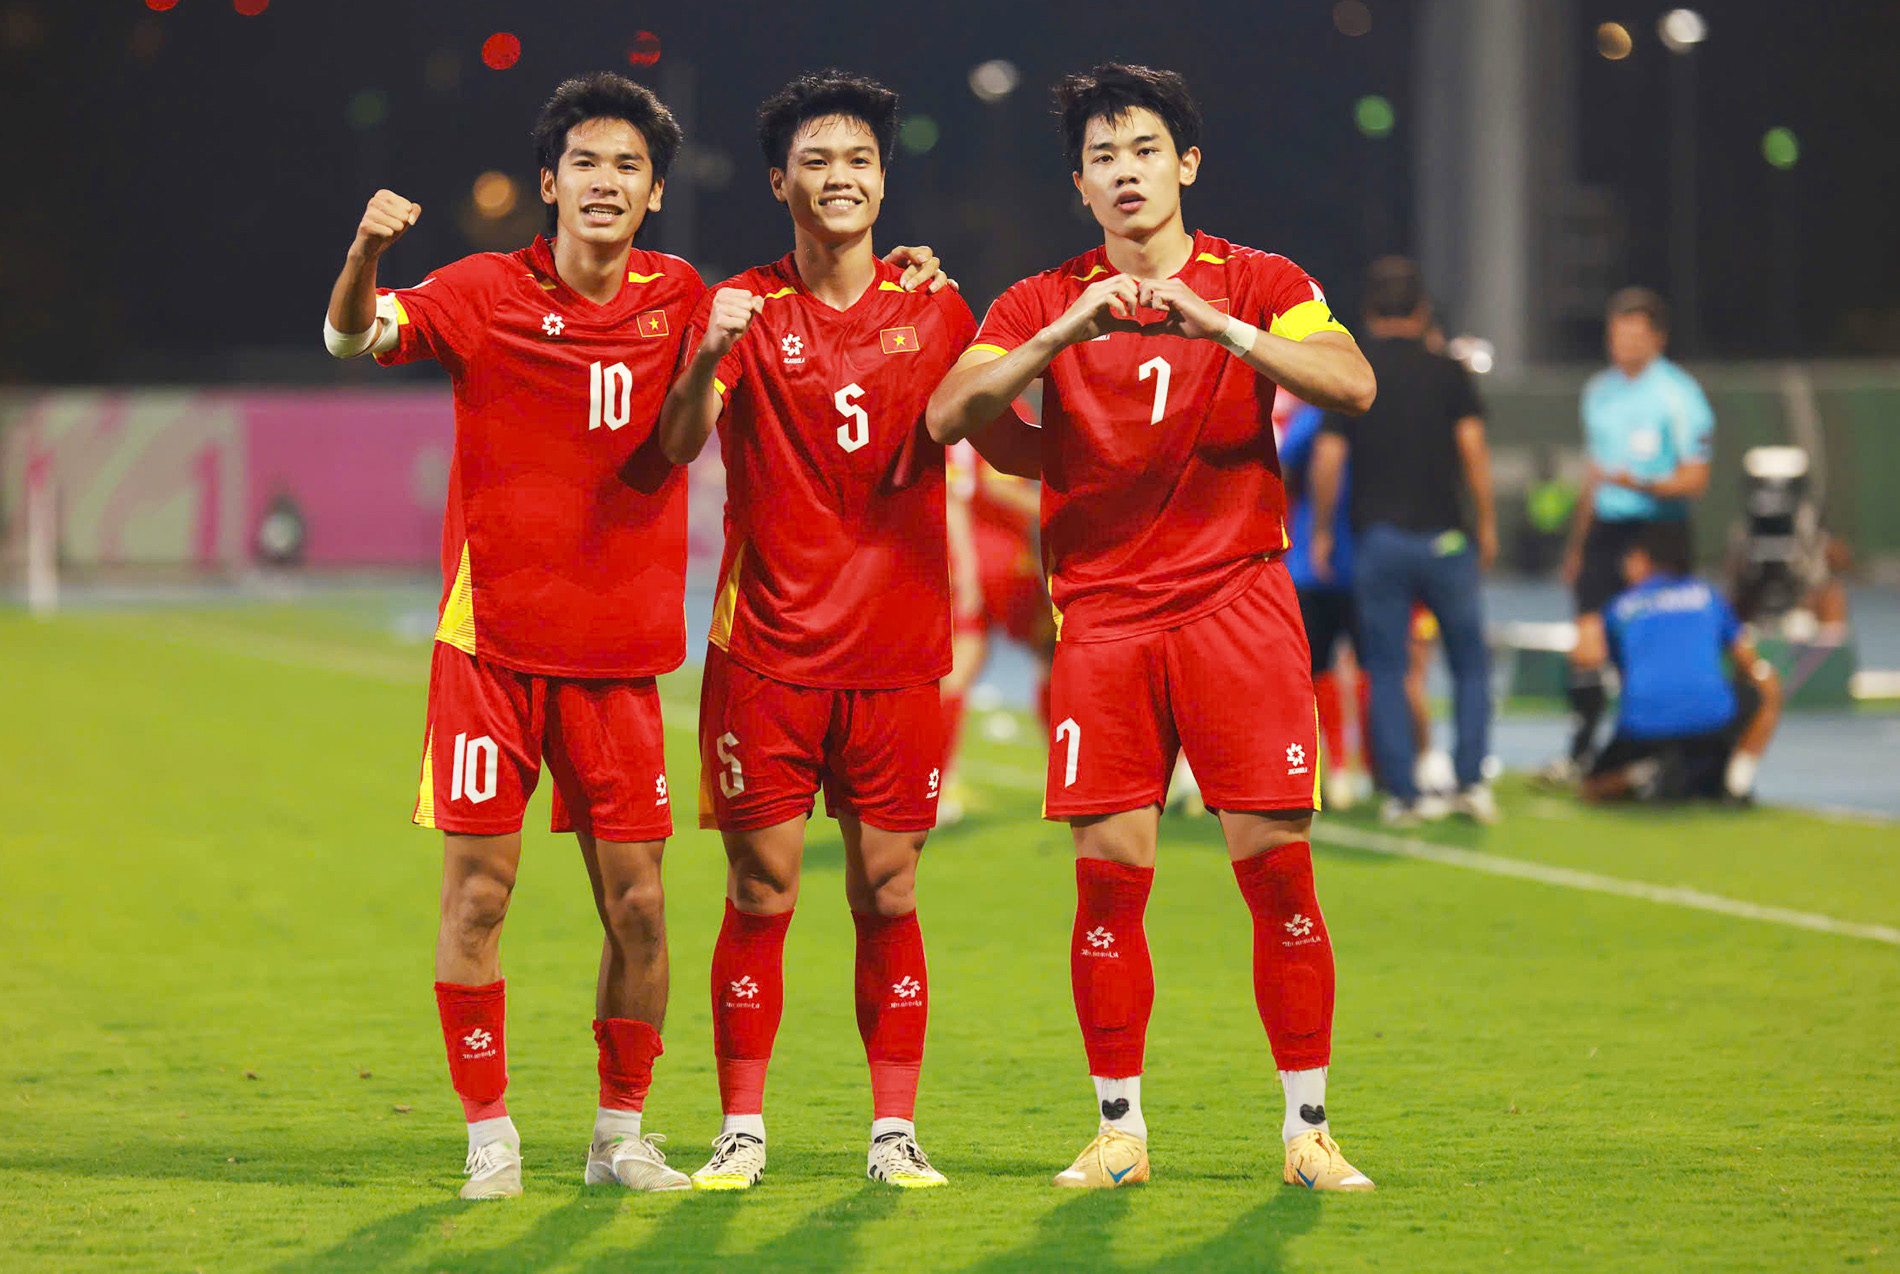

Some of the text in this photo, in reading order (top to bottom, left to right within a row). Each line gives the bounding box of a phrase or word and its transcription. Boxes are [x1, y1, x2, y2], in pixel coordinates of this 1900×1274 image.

[588, 361, 633, 430] 10
[1138, 356, 1171, 425] 7
[451, 732, 498, 804] 10
[1055, 718, 1081, 788] 7
